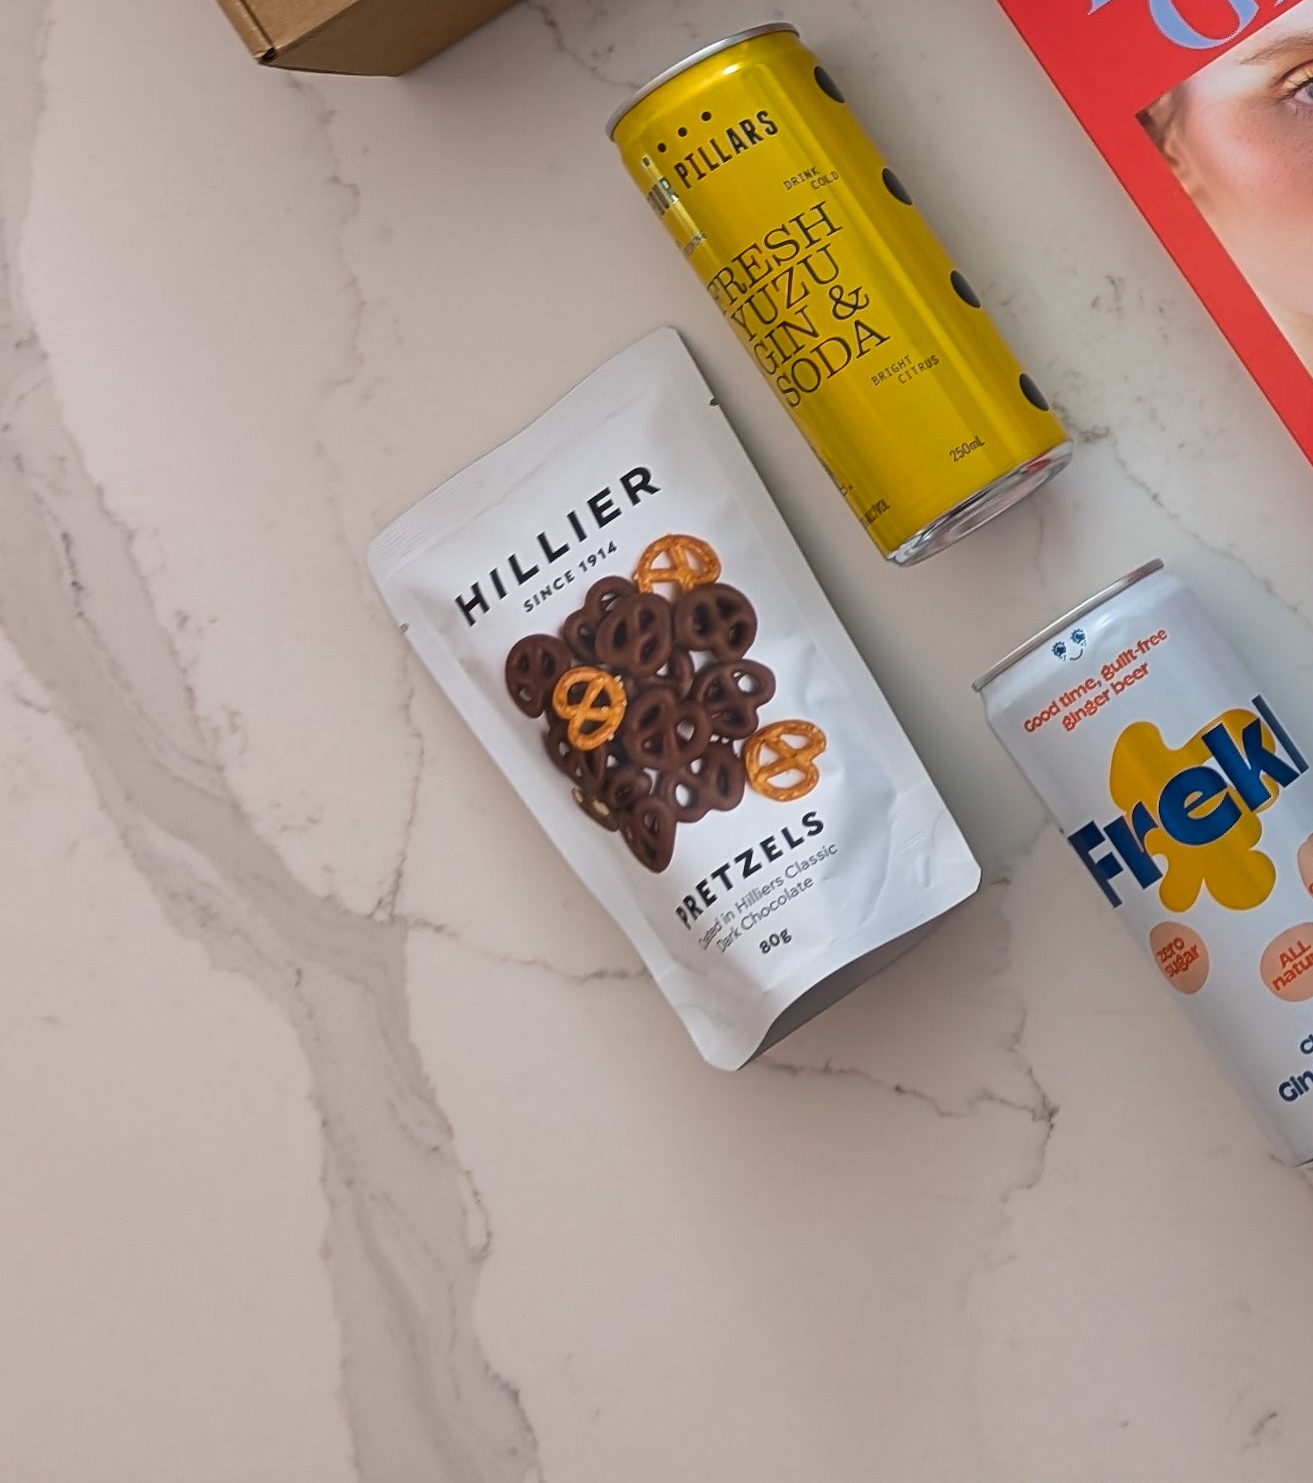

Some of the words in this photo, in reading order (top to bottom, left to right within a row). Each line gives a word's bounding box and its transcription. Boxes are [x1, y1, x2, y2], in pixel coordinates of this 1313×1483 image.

[672, 109, 779, 190] PILLARS
[782, 165, 821, 191] DRINK
[809, 170, 840, 190] COLD
[728, 243, 842, 343] YUZU
[747, 302, 829, 378] GIN
[827, 283, 870, 321] &
[775, 318, 891, 410] SODA
[869, 353, 912, 387] BRIGHT
[896, 353, 940, 385] CITRUS
[948, 433, 986, 463] 250mL
[454, 465, 661, 627] HILLIER
[522, 568, 576, 613] SINCE
[578, 540, 618, 572] 1914
[1023, 699, 1062, 734] Good
[1058, 677, 1103, 708] time,
[1099, 628, 1168, 682] guilt-free
[1060, 688, 1111, 732] ginger
[1109, 661, 1149, 696] beer
[1064, 692, 1311, 910] Frekl
[674, 810, 824, 931] PRETZELS
[758, 927, 793, 954] 80g
[1155, 936, 1185, 964] zero
[1163, 943, 1200, 978] sugar
[1278, 939, 1312, 969] ALL
